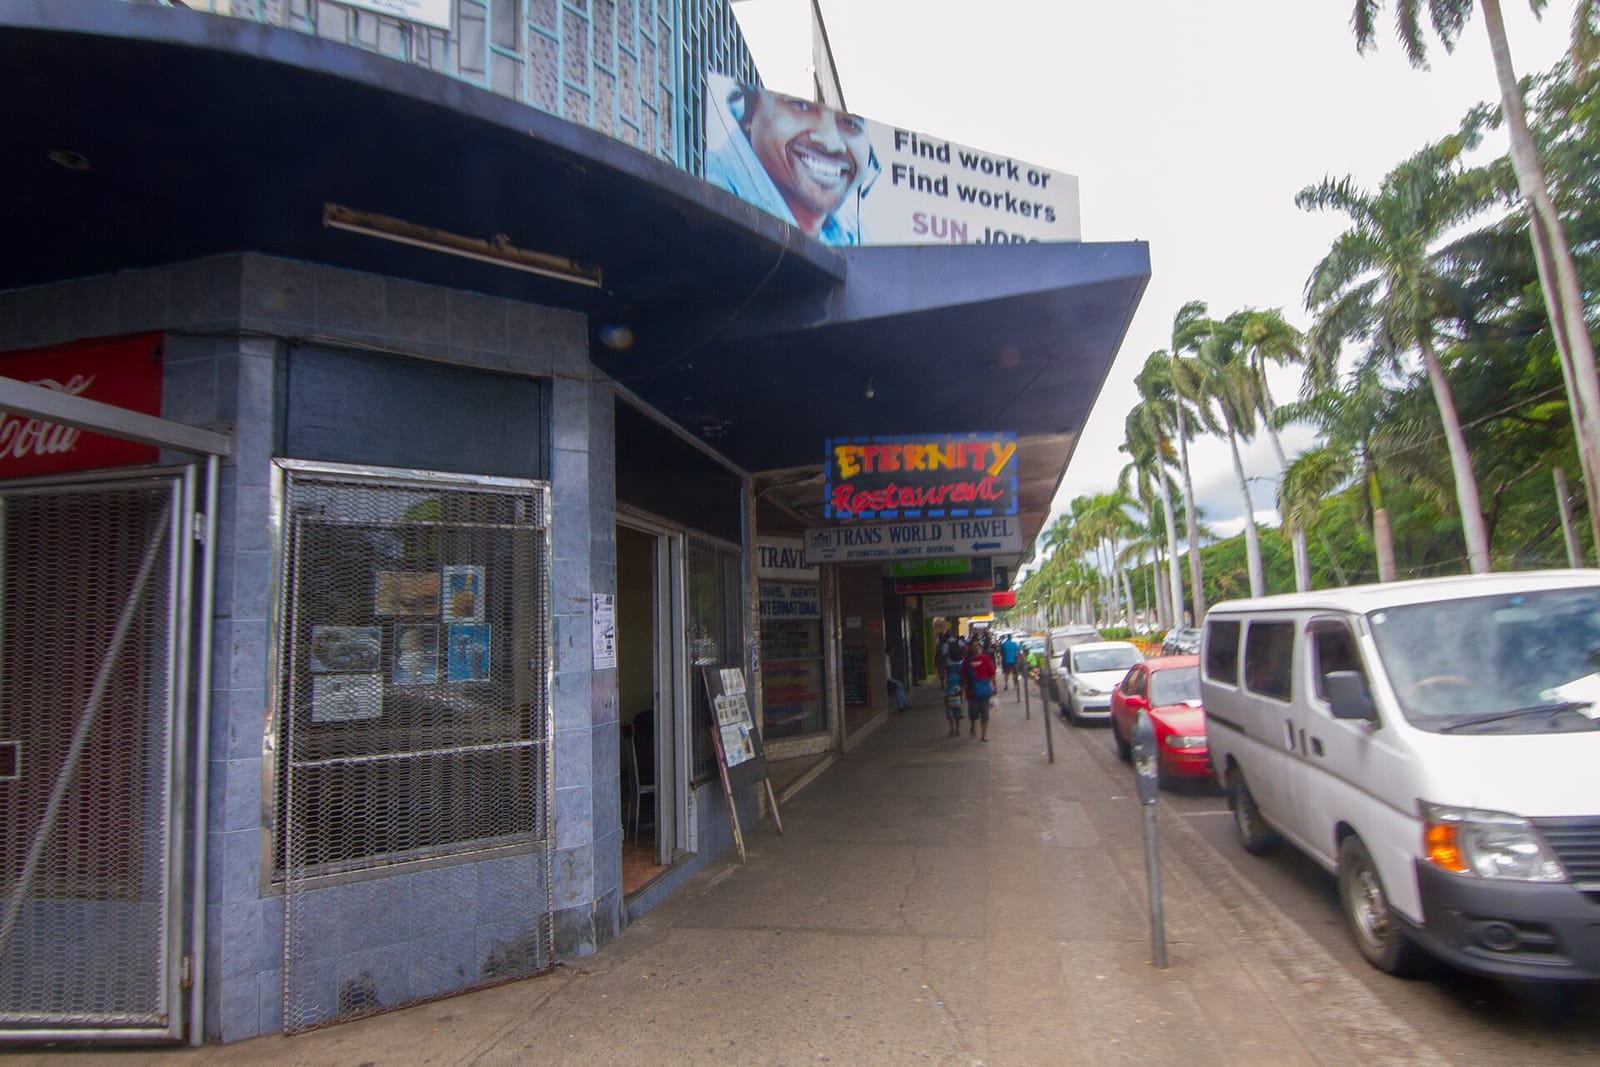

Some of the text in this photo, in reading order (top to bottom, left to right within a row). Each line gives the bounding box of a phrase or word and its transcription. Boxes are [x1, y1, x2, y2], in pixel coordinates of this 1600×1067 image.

[894, 129, 1051, 189] Find work or
[892, 163, 1056, 223] Find workers
[912, 210, 968, 245] SUN
[835, 440, 1017, 479] ETERNITY
[831, 476, 1005, 513] Restaurant
[833, 527, 882, 546] TRANS
[889, 523, 942, 544] WORLD
[946, 519, 1013, 540] TRAVEL
[758, 546, 814, 569] TRAVE
